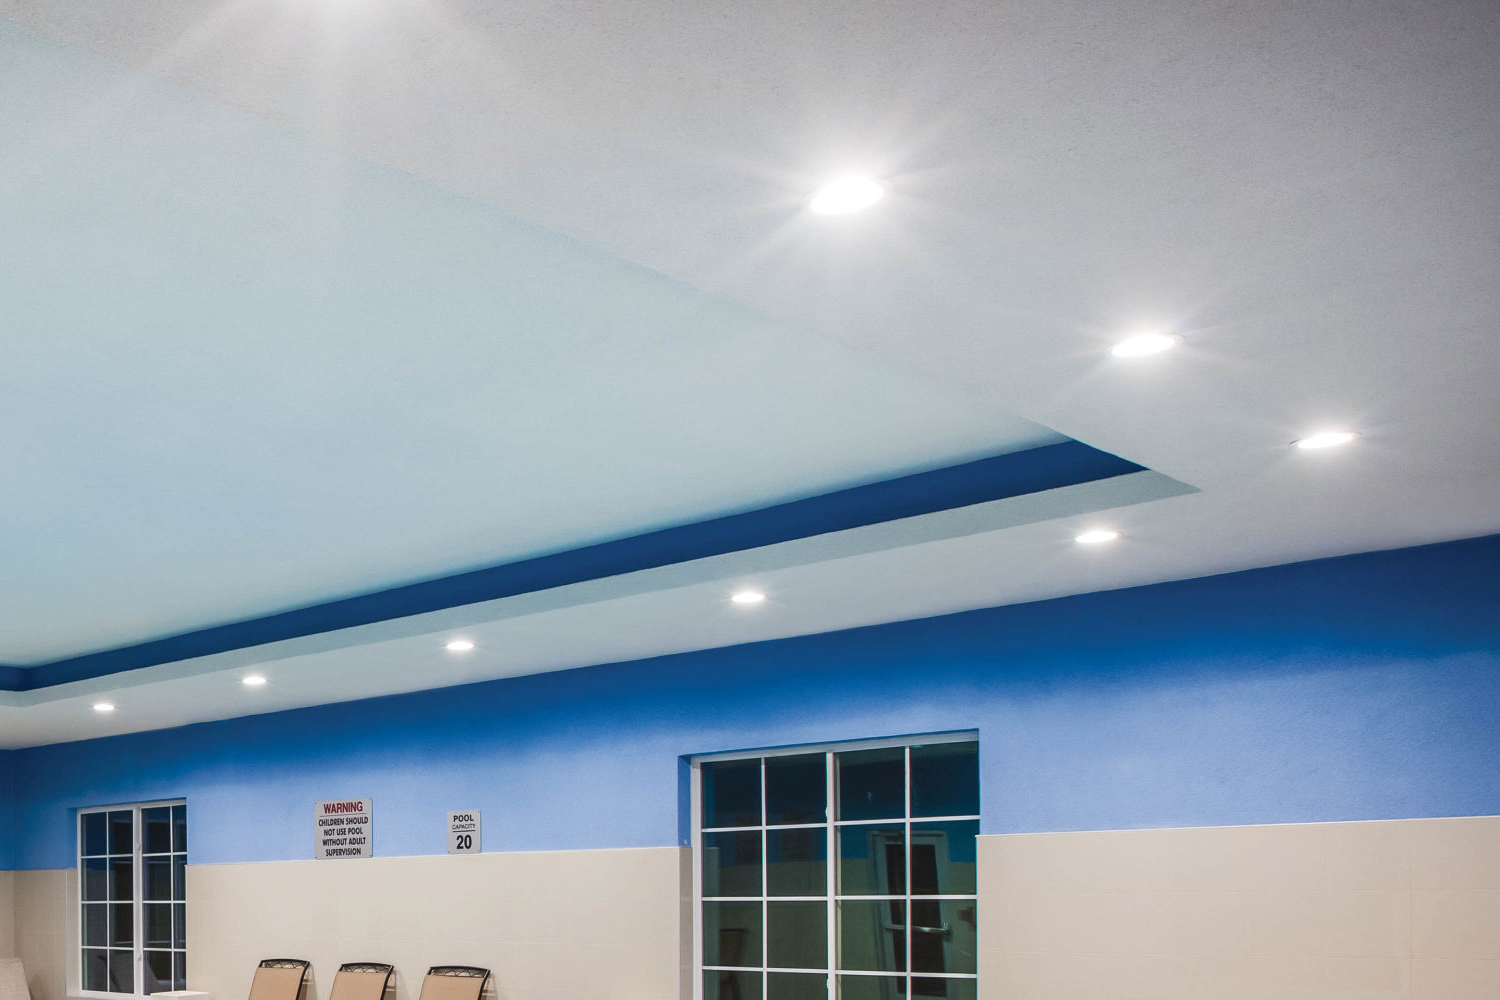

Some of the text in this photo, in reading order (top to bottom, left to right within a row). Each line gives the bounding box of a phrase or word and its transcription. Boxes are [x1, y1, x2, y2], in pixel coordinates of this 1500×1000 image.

[323, 801, 363, 814] WARNING
[318, 816, 368, 826] CHILDREN SHOULD
[453, 814, 474, 822] POOL
[323, 827, 363, 836] NOT USE POOL
[322, 837, 366, 846] WITHOUT ADULT
[456, 834, 472, 849] 20
[325, 848, 361, 856] SUPERVISION
